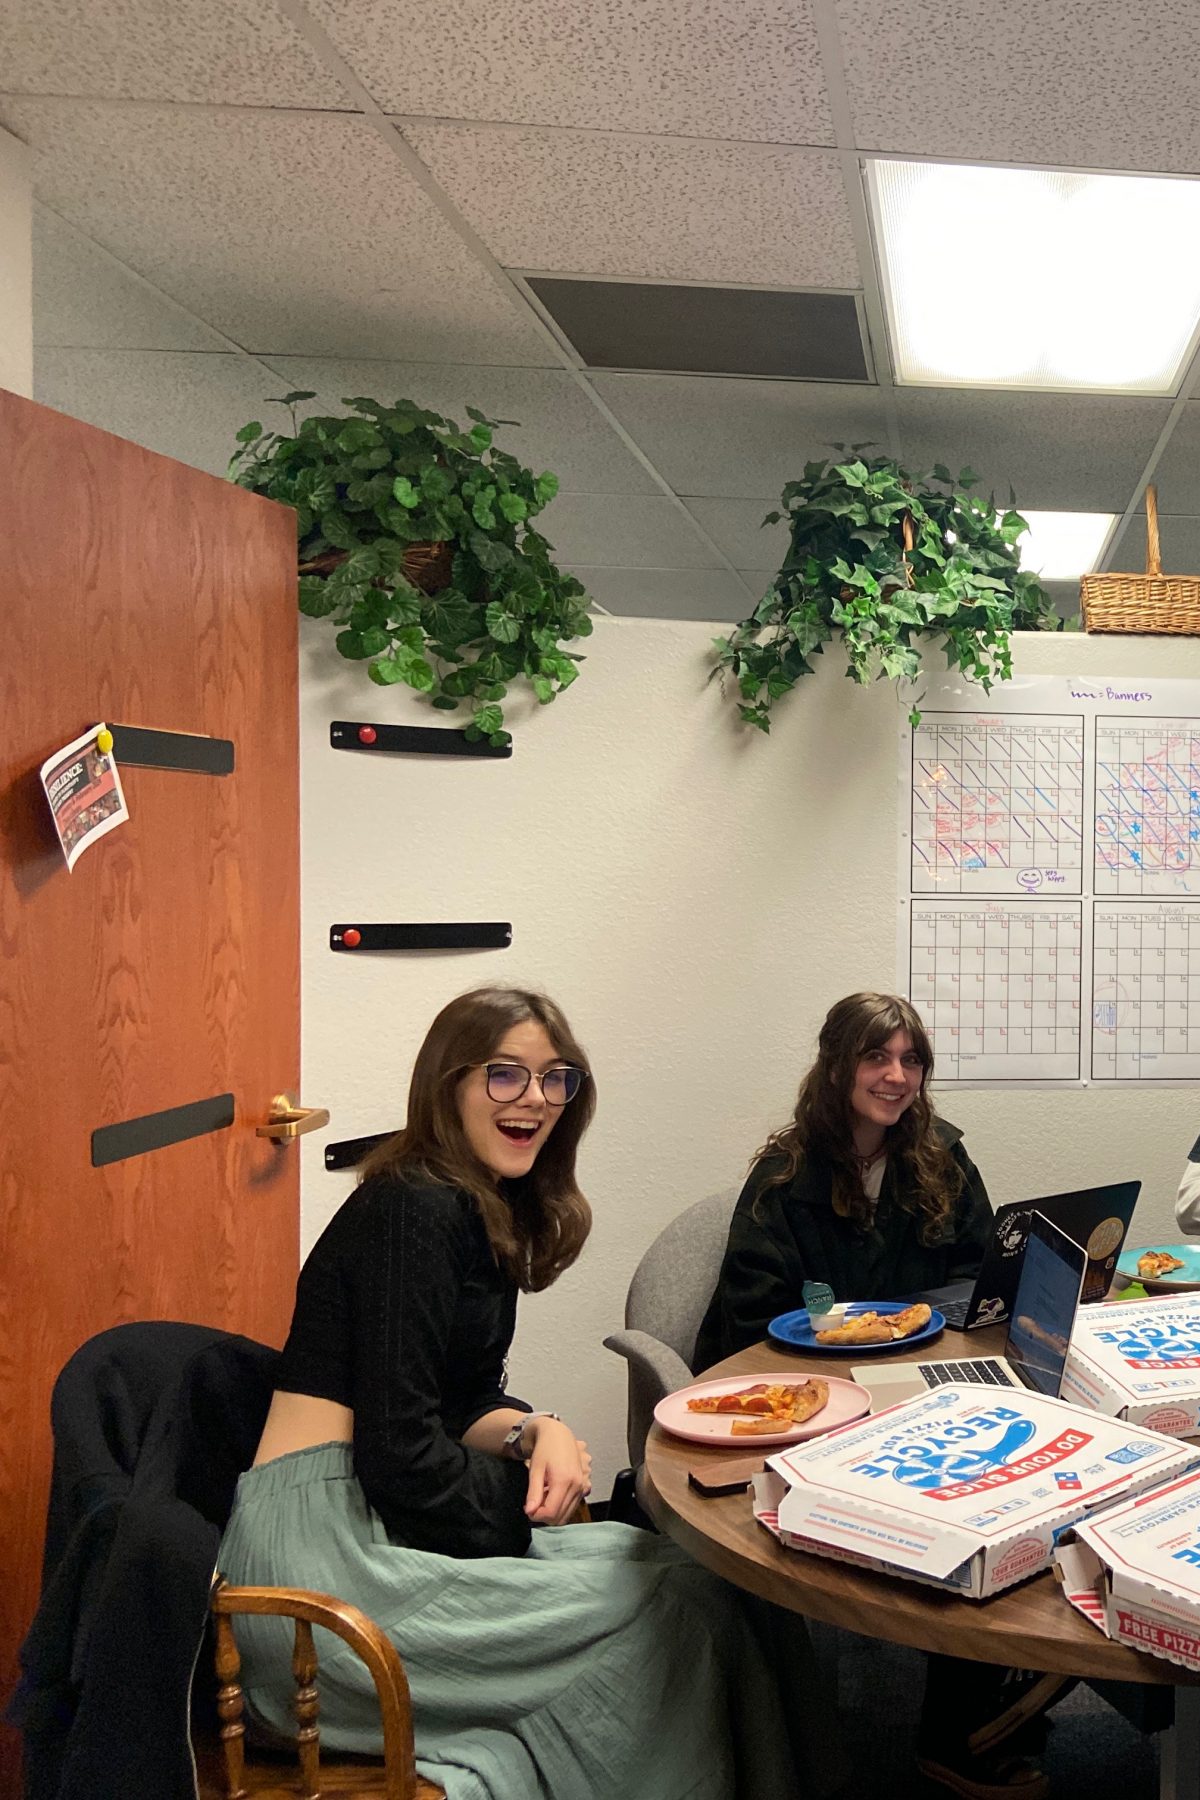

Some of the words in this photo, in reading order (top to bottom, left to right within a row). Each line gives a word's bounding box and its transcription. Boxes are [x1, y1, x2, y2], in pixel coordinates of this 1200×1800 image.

[808, 1295, 832, 1304] RANCH
[902, 1419, 953, 1434] PIZZA
[1154, 1418, 1190, 1430] GUARANTEE
[850, 1406, 1023, 1479] RECYCLE
[880, 1435, 899, 1451] BOX
[1057, 1433, 1084, 1451] DO
[1006, 1450, 1062, 1476] YOUR
[935, 1475, 1009, 1498] SLICE
[1134, 1506, 1188, 1534] CARRYOUT
[996, 1566, 1008, 1576] OUR
[1010, 1549, 1044, 1572] GUARANTEE
[1124, 1618, 1158, 1644] FREE
